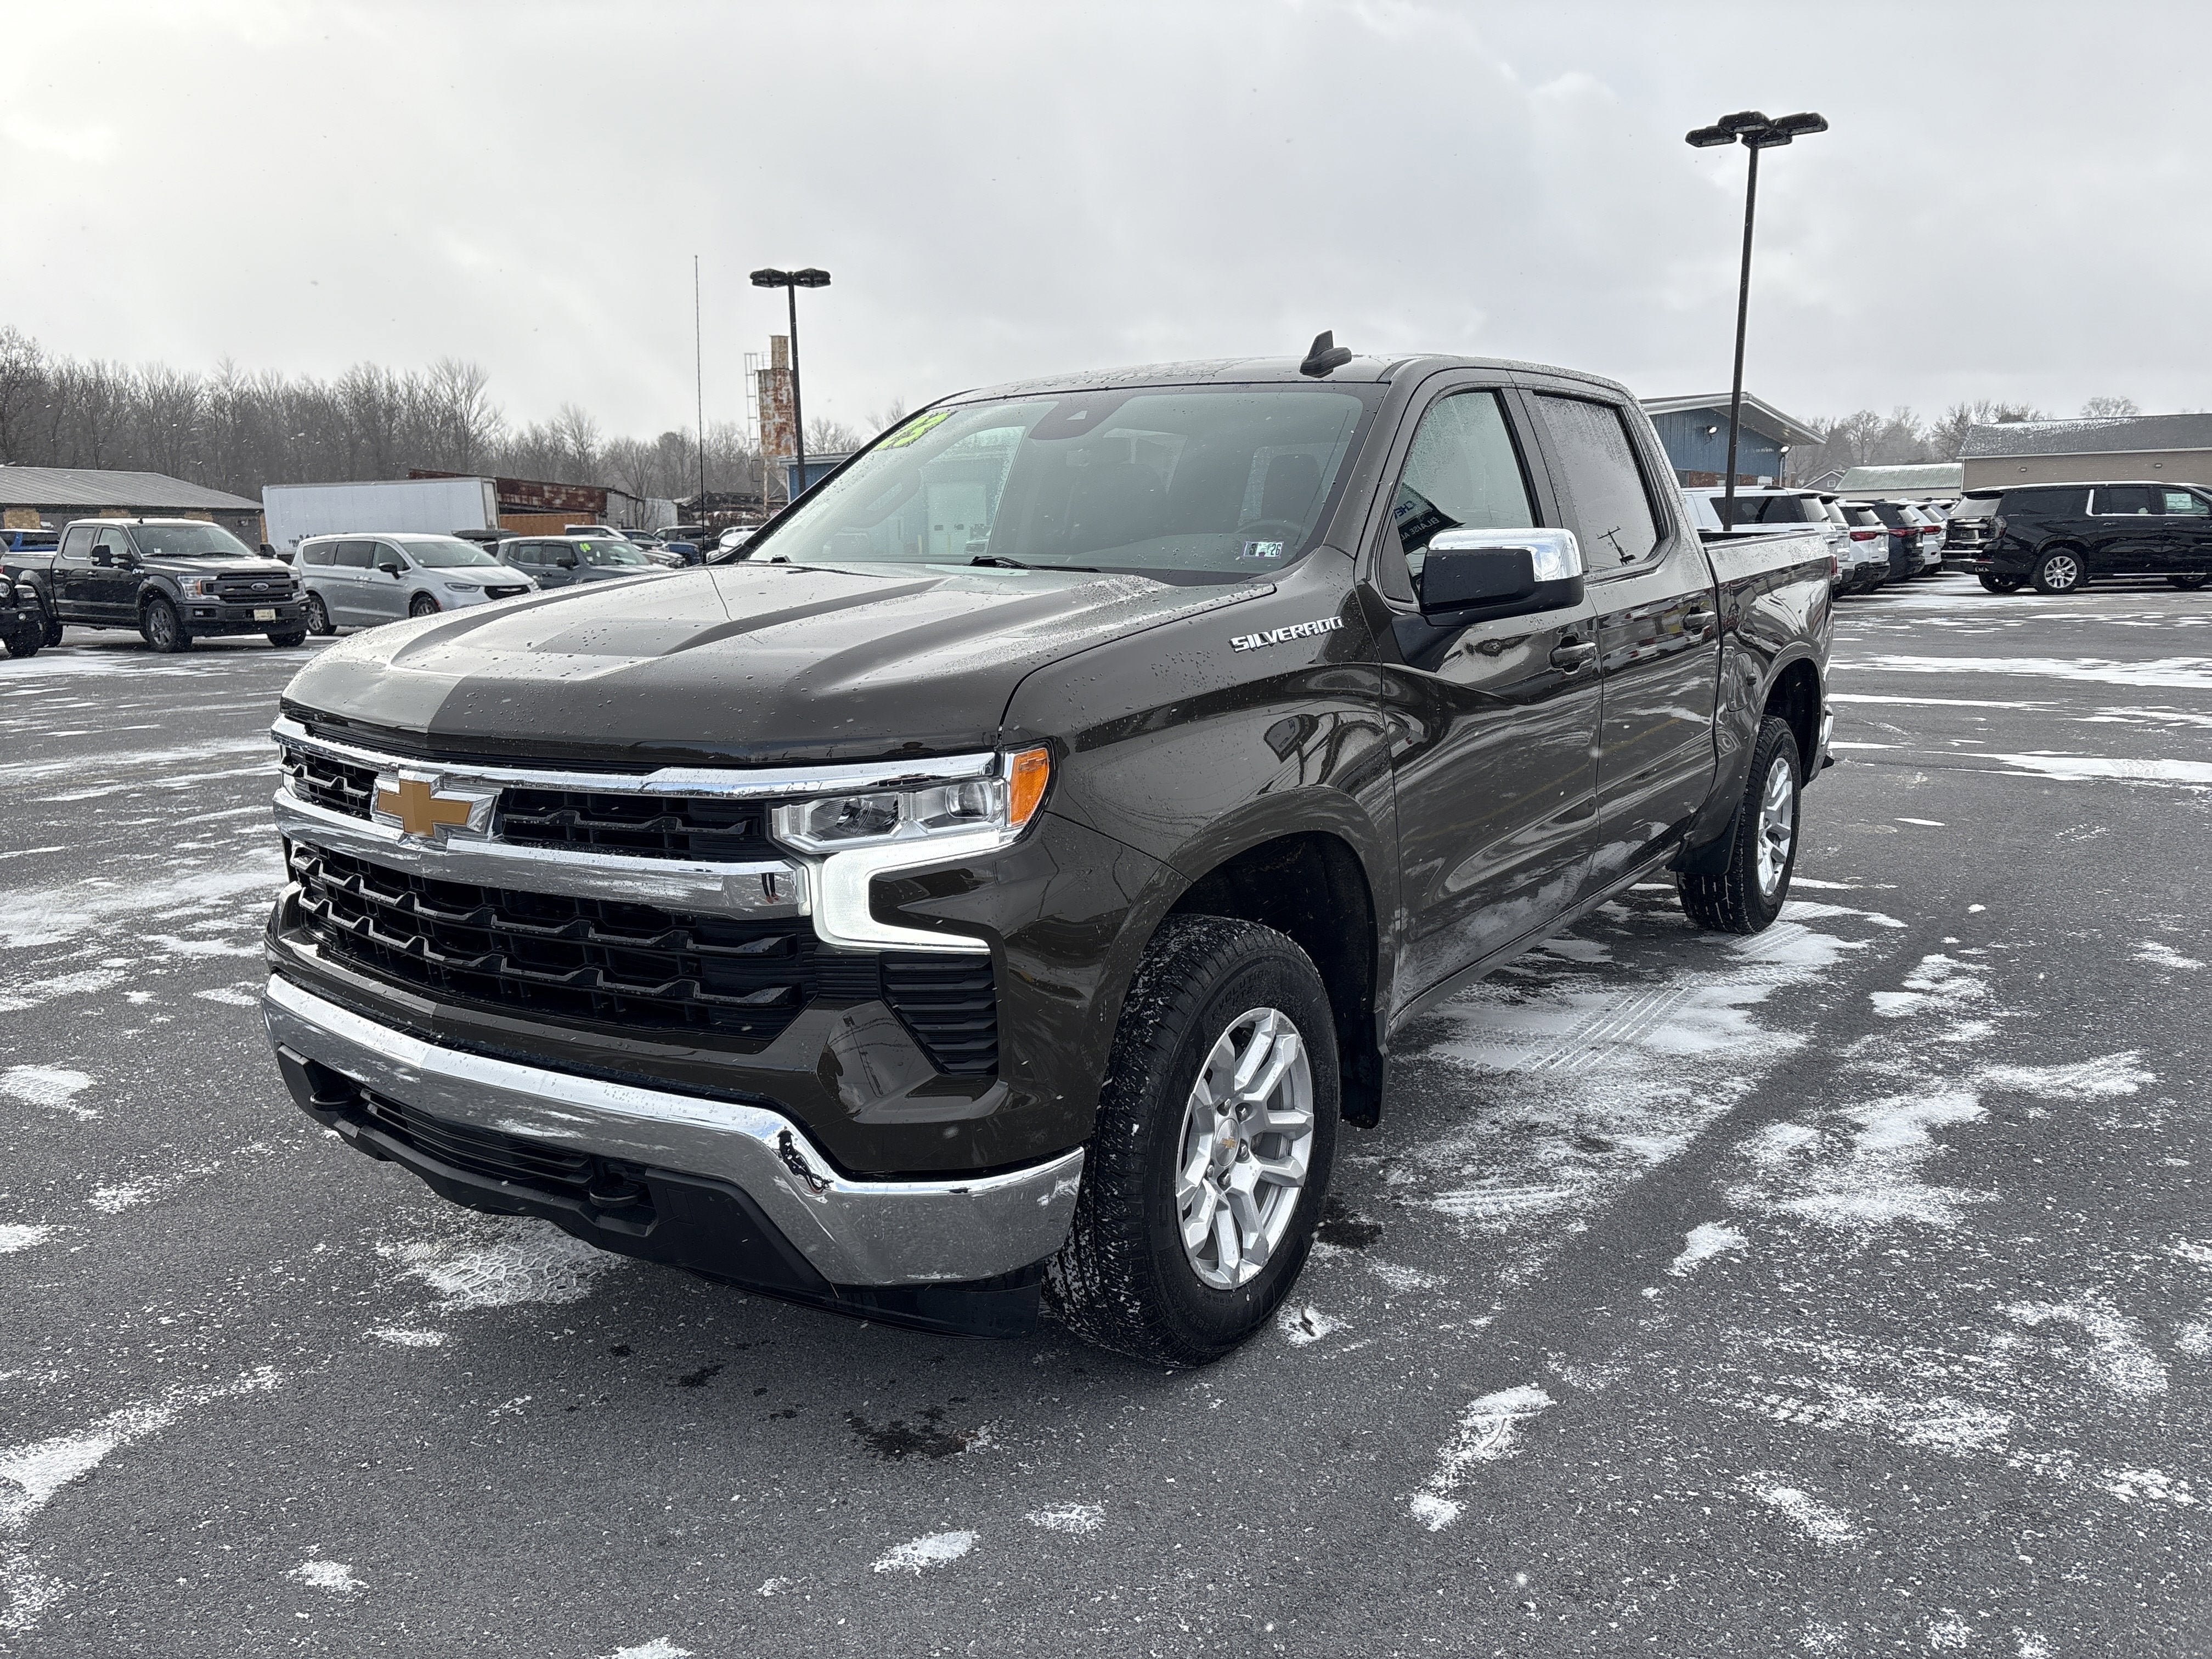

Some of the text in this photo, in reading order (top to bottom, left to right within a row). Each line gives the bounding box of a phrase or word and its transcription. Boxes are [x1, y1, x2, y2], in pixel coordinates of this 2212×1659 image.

[1249, 543, 1282, 555] 3 26
[1229, 616, 1344, 652] SILVERADO
